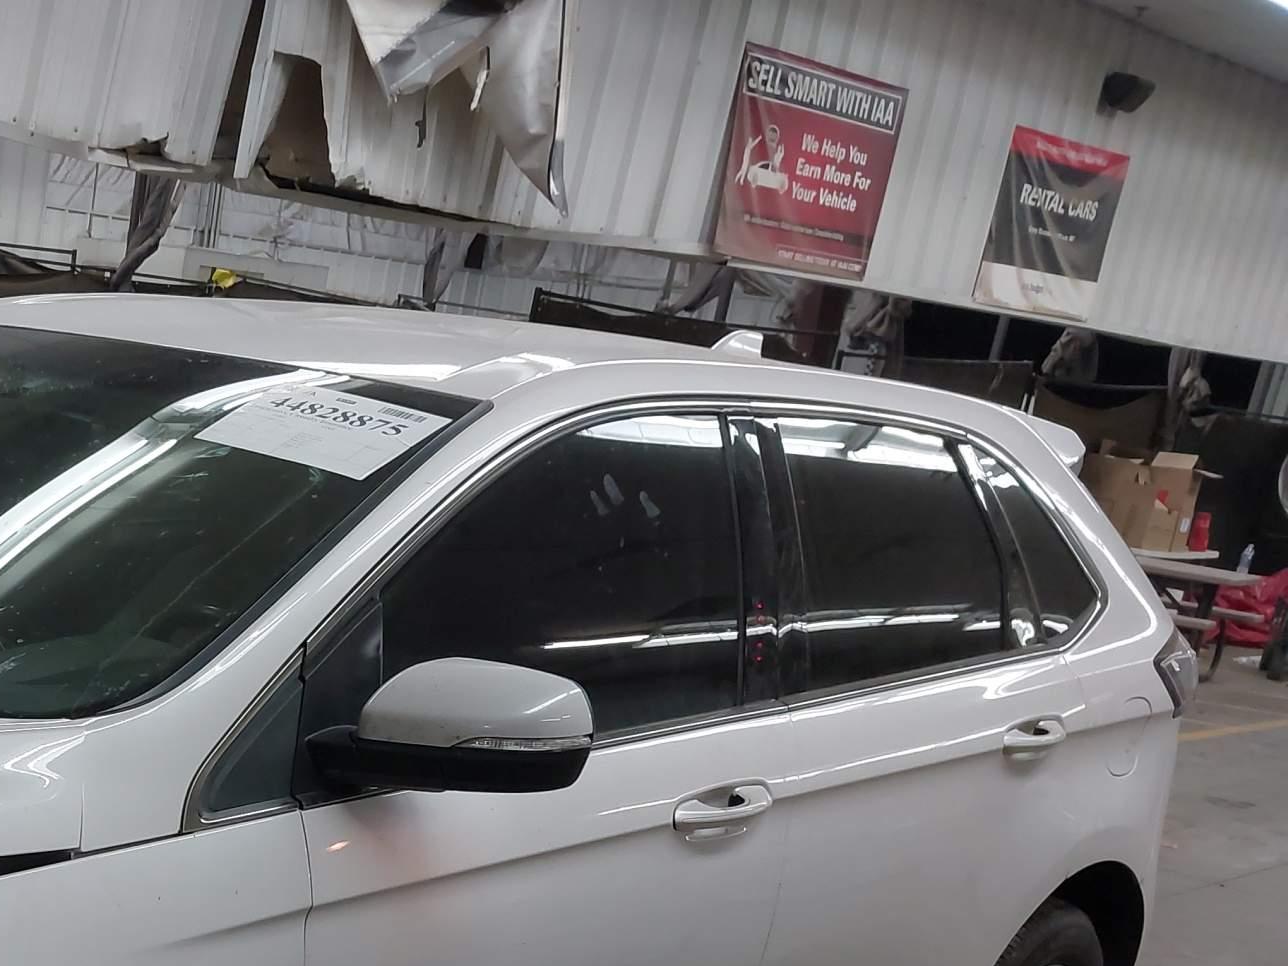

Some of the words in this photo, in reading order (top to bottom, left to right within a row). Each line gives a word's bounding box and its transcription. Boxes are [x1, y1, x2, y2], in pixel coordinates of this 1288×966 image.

[748, 61, 782, 95] SELL
[784, 71, 836, 109] SMART
[835, 87, 871, 119] WITH
[871, 97, 894, 127] IAA
[801, 132, 819, 154] We
[820, 138, 846, 164] Help
[849, 144, 868, 166] You
[795, 157, 821, 180] Earn
[823, 163, 851, 187] More
[852, 171, 872, 191] For
[792, 180, 817, 204] Your
[819, 187, 857, 212] Vehicle
[1019, 183, 1065, 215] RENTAL
[1067, 199, 1099, 222] CARS
[270, 397, 409, 436] 44828875
